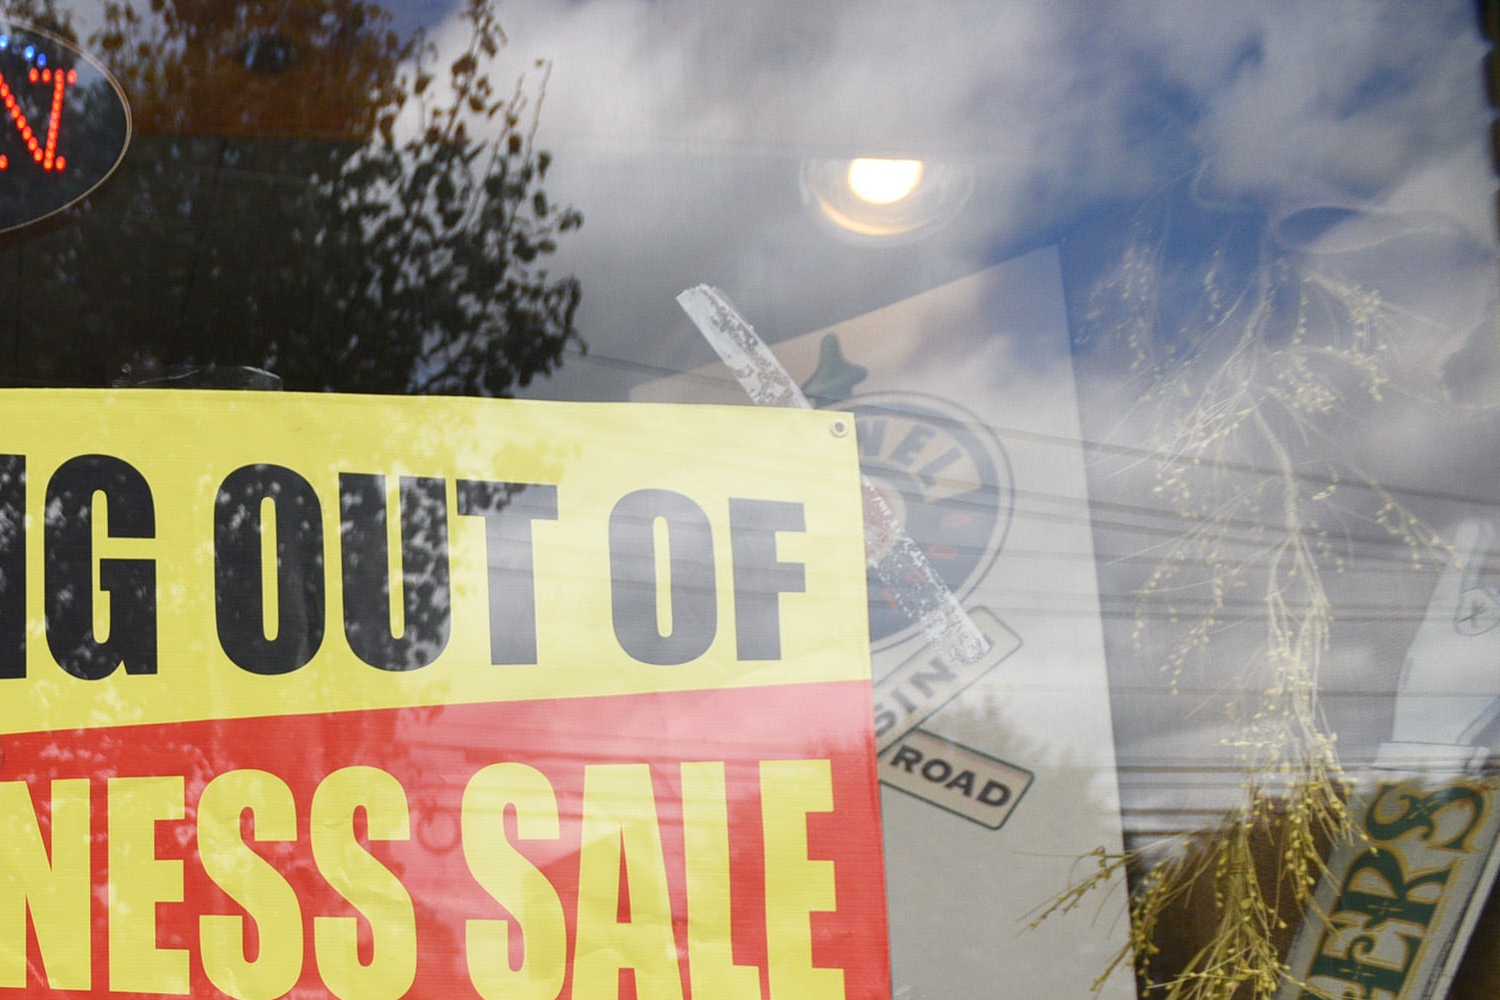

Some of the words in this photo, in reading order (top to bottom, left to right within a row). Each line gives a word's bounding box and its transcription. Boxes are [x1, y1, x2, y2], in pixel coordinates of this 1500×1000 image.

[213, 462, 557, 676] OUT
[608, 488, 807, 671] OF
[890, 743, 1013, 808] ROAD
